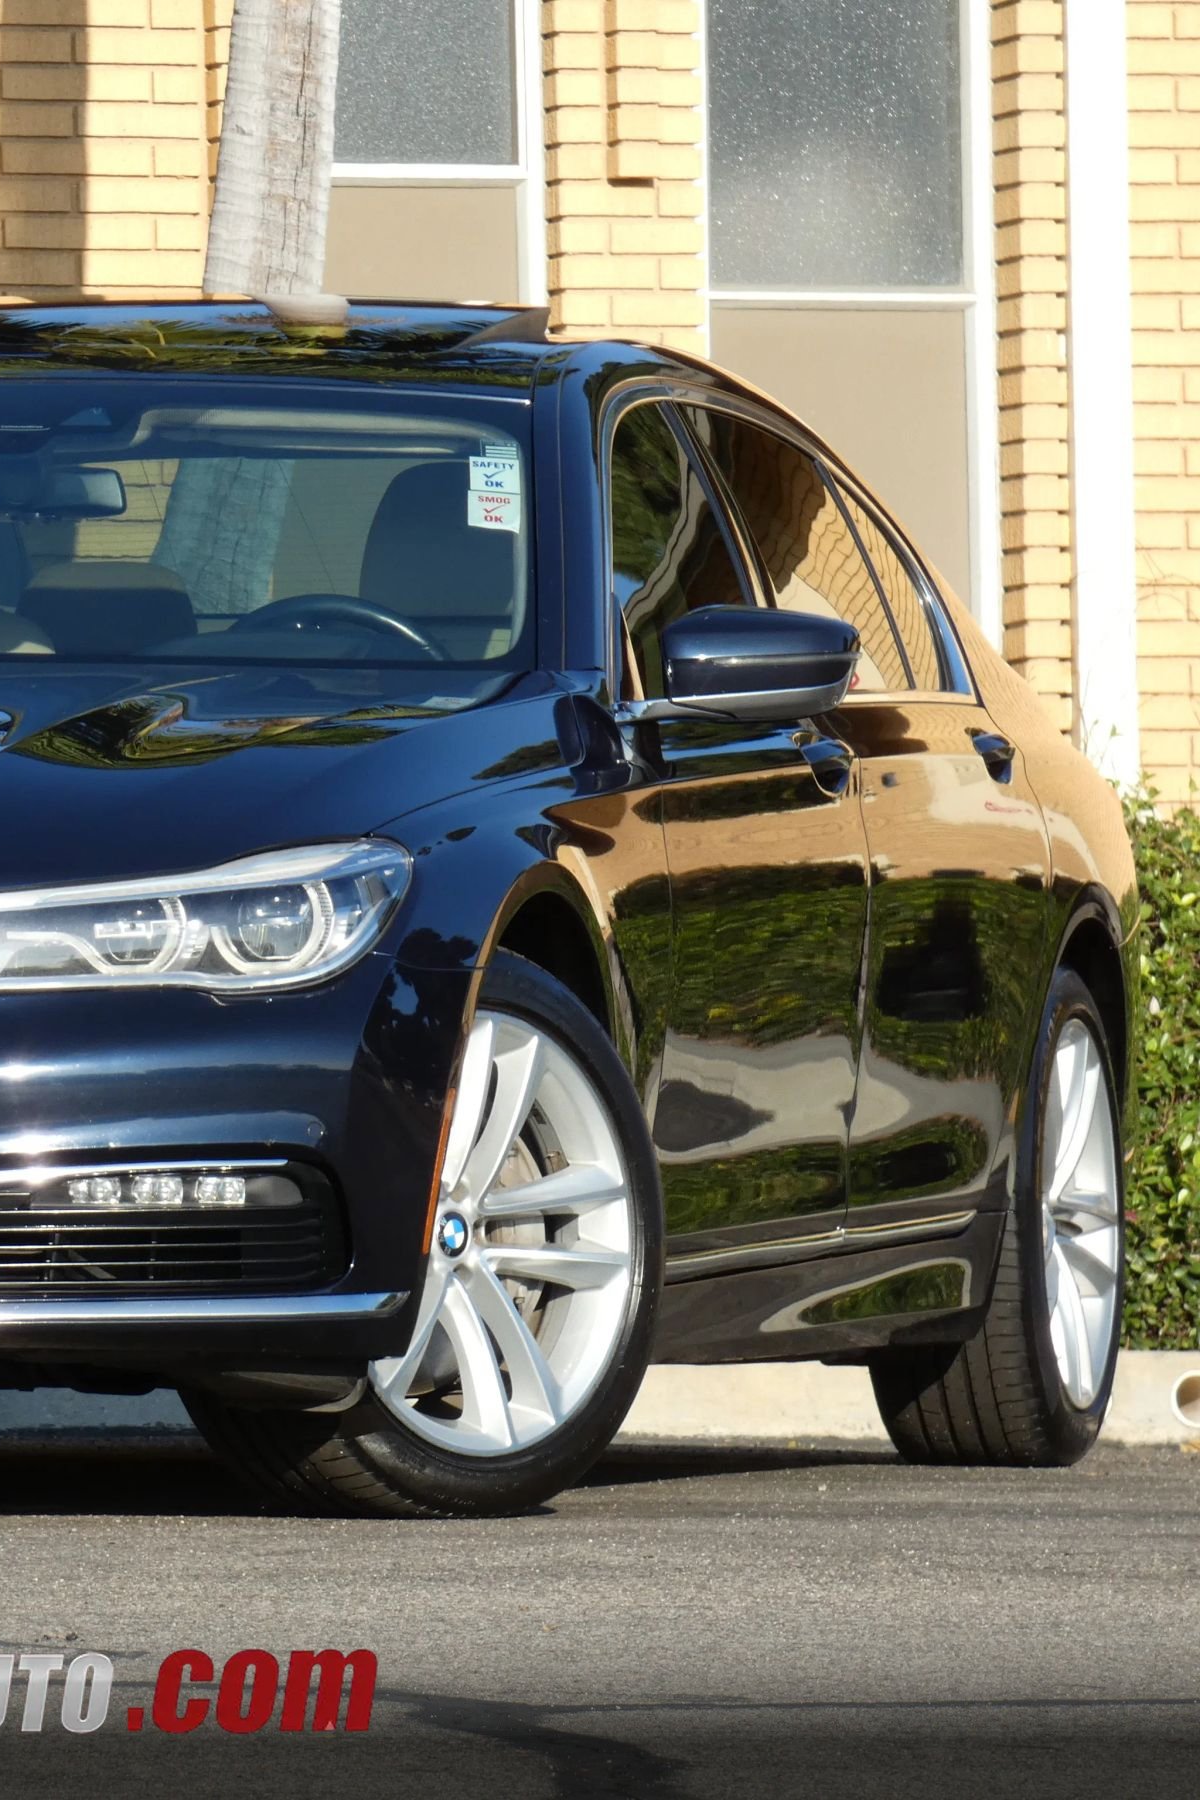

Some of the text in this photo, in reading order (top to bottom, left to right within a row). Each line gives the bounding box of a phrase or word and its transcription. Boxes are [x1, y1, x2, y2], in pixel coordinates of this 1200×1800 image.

[473, 461, 514, 470] SAFETY
[478, 496, 510, 504] SMOG
[484, 515, 503, 523] OK
